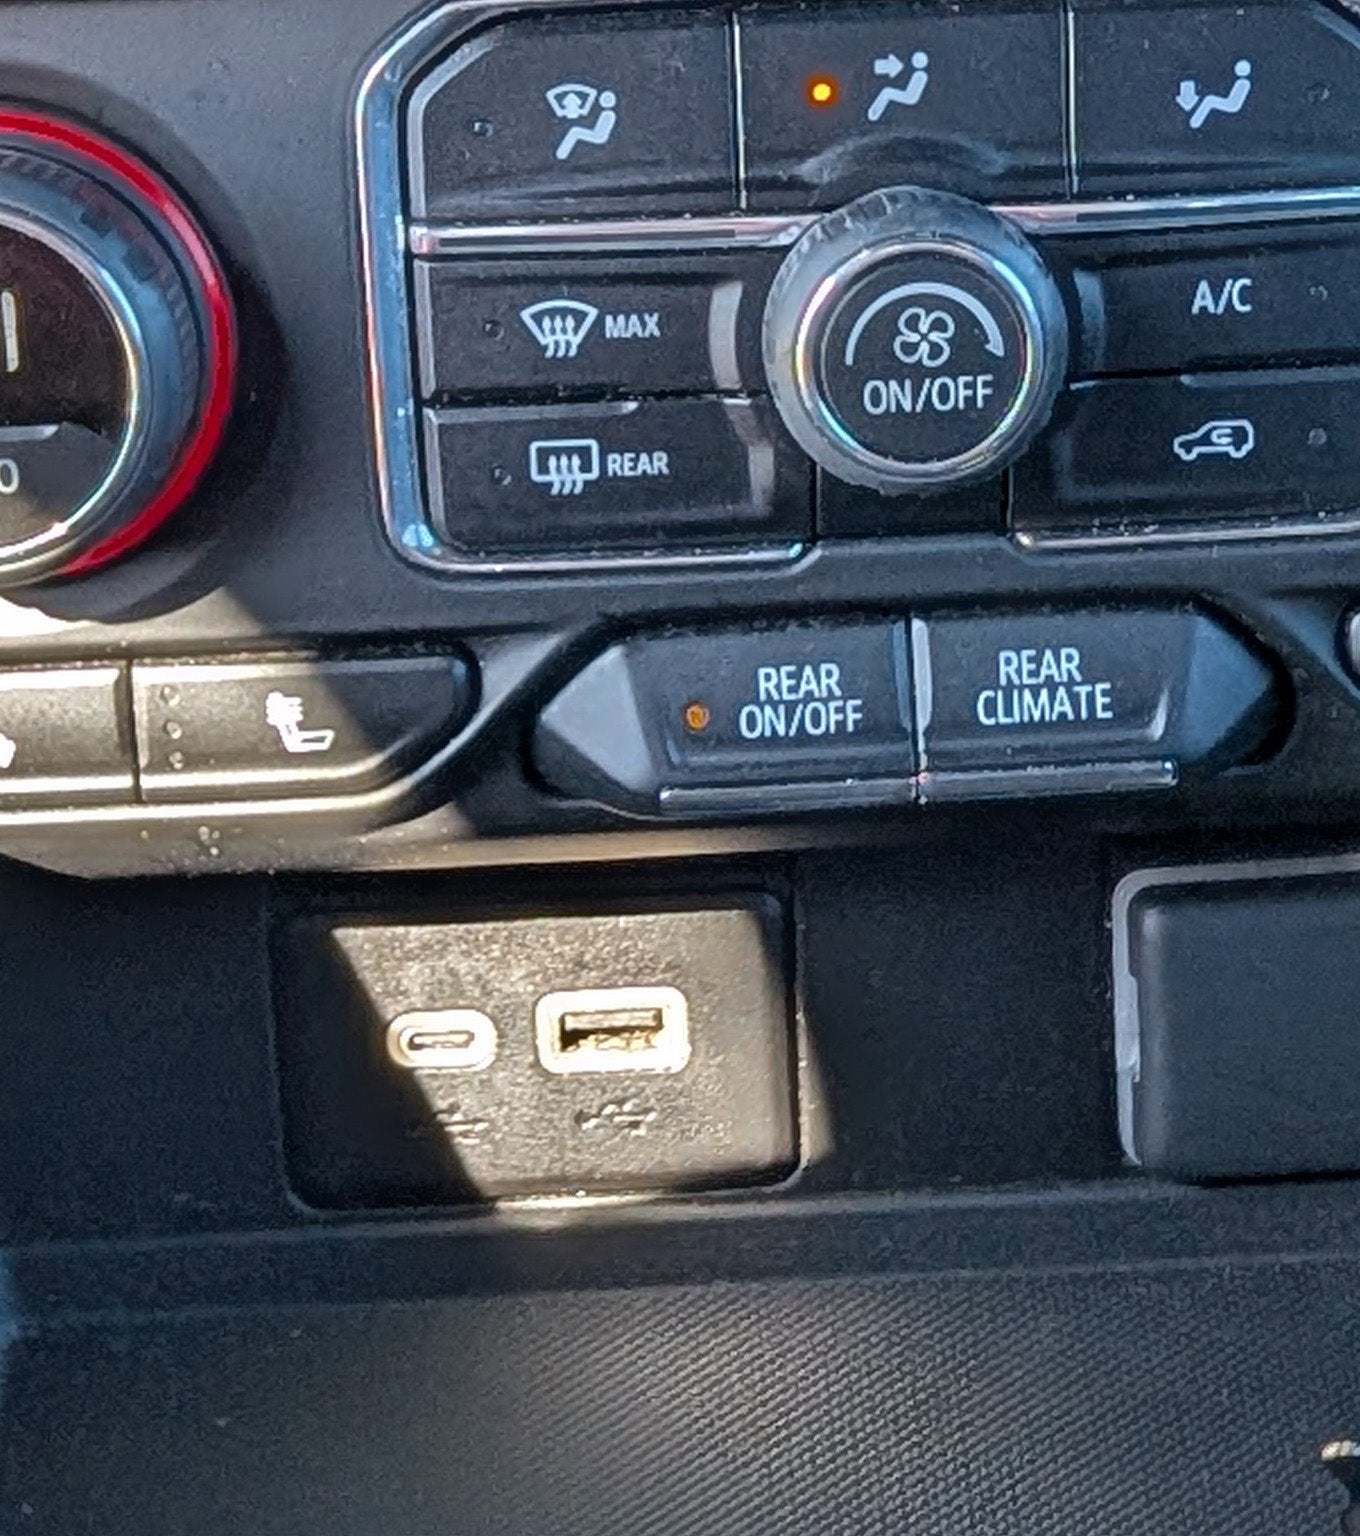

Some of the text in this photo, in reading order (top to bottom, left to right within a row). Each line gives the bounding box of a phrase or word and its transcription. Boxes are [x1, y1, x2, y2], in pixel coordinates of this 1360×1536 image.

[1191, 277, 1253, 315] A/C
[605, 312, 660, 339] MAX
[863, 373, 993, 415] ON/OFF
[607, 451, 670, 477] REAR
[757, 662, 841, 702] REAR
[998, 647, 1082, 686] REAR
[739, 699, 863, 739] ON/OFF
[977, 683, 1114, 727] CLIMATE
